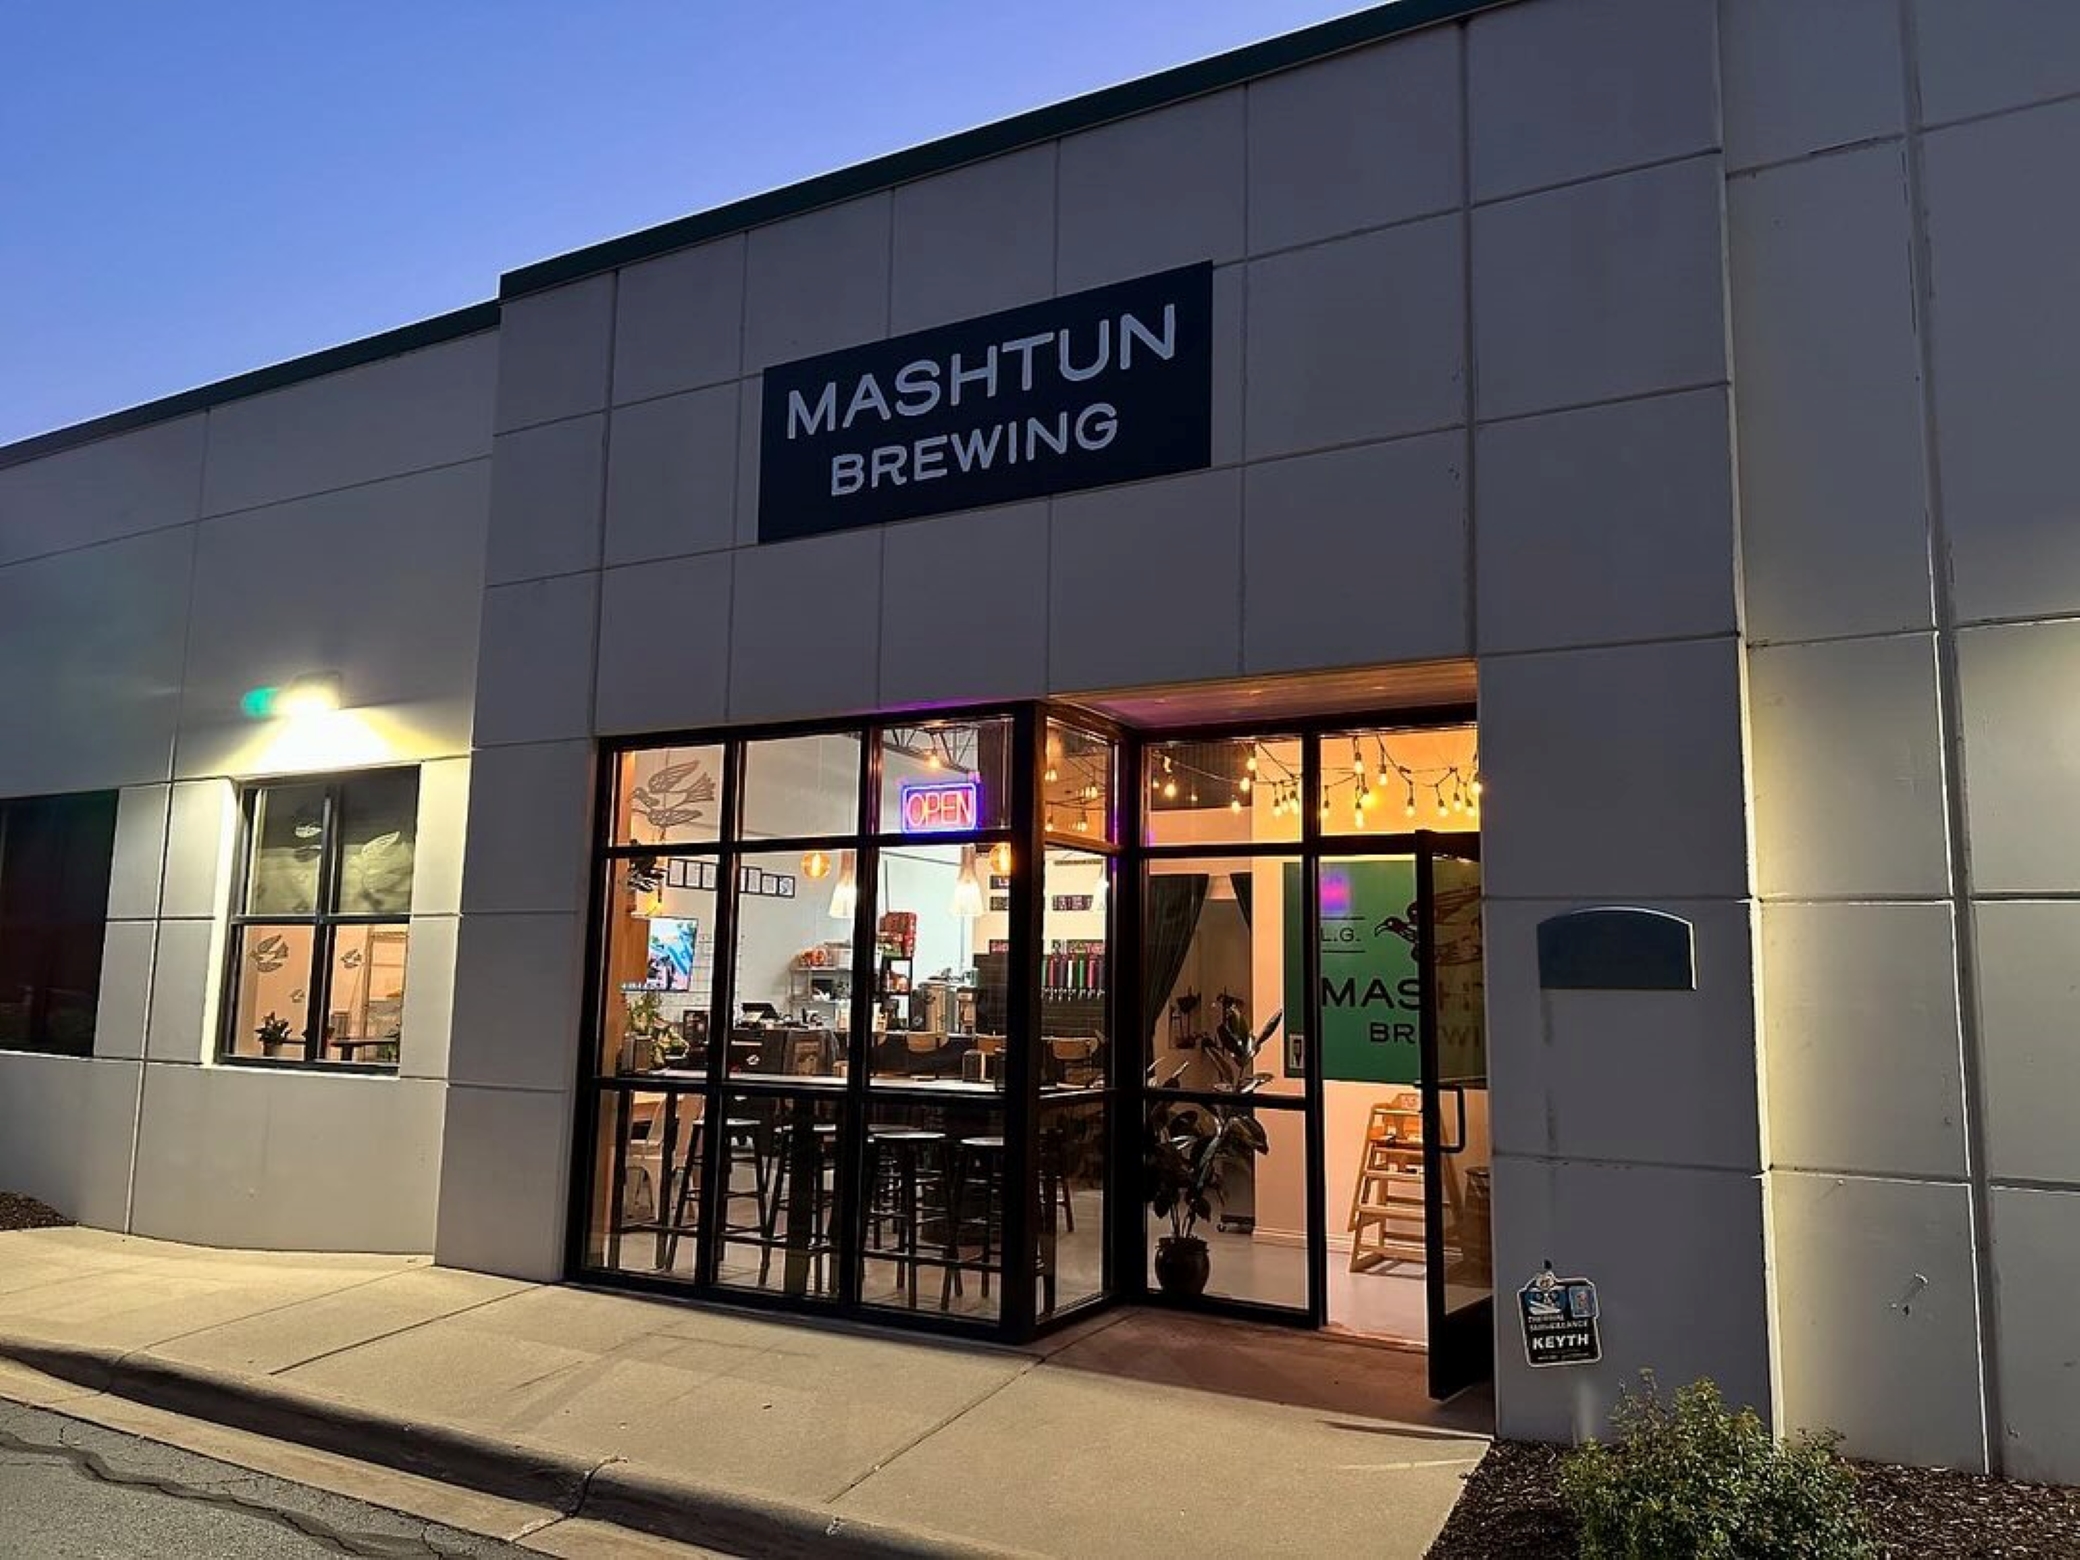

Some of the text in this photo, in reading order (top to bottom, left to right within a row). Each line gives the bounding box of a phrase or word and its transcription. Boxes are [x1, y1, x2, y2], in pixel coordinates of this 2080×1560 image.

[786, 303, 1176, 440] MASHTUN
[830, 402, 1119, 497] BREWING
[906, 789, 973, 827] OPEN
[1532, 1333, 1590, 1351] KEYTH
